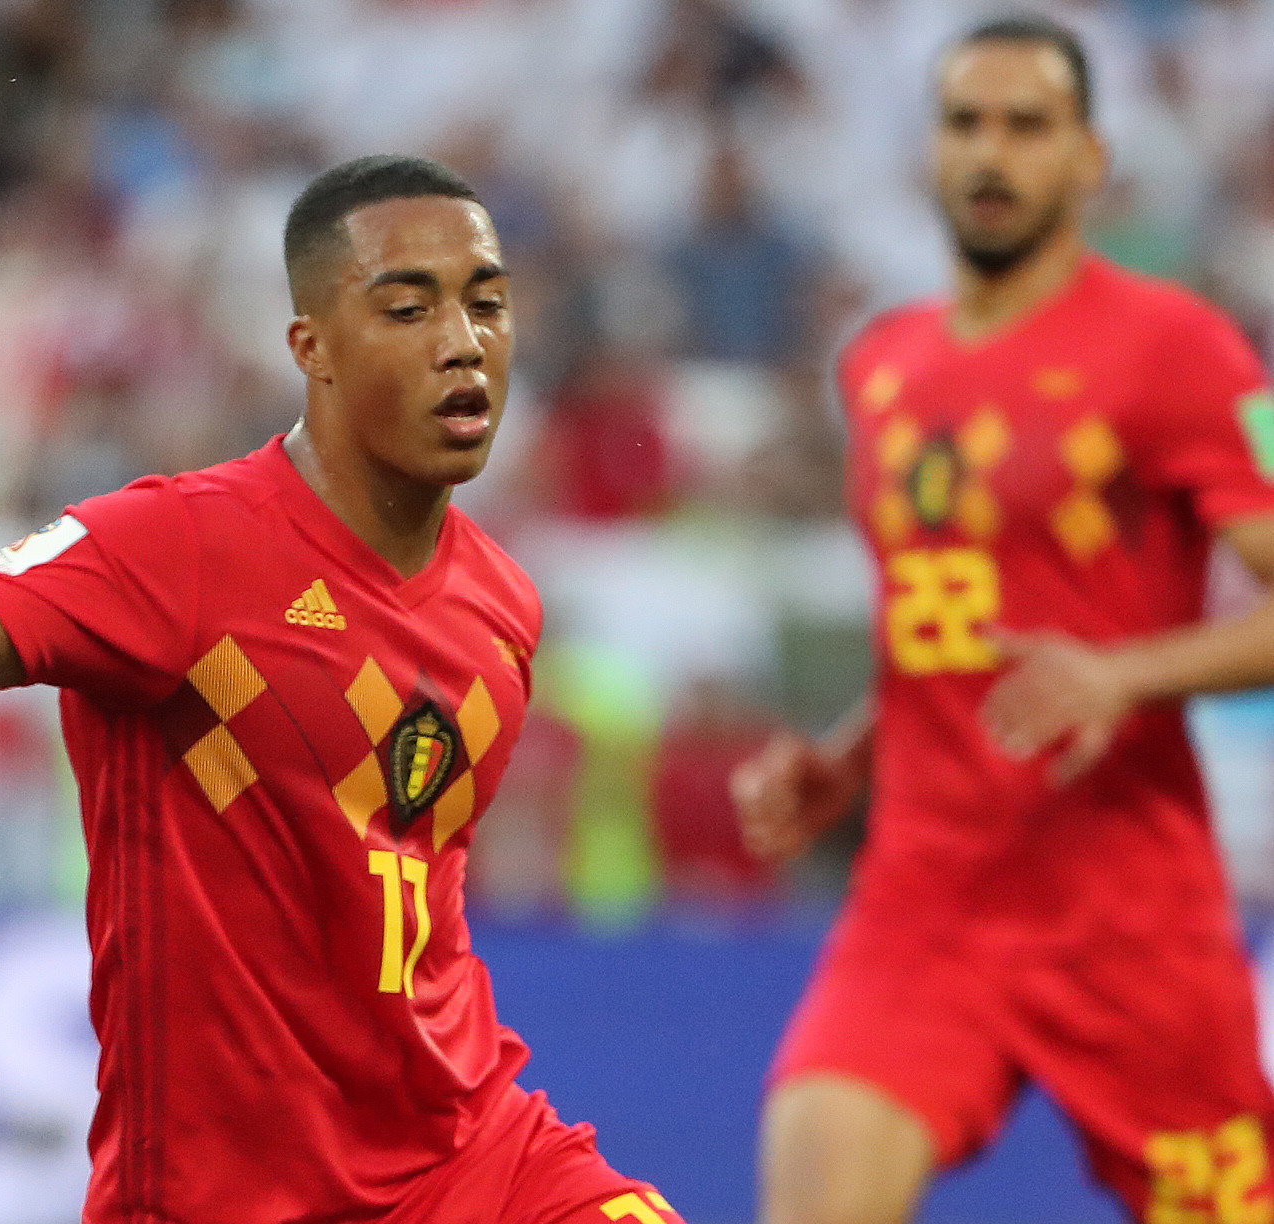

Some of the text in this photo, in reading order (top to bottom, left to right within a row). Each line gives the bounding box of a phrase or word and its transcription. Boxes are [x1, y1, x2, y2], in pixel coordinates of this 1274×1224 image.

[284, 608, 347, 631] adidas
[888, 546, 1000, 677] 22
[368, 849, 432, 1000] 17
